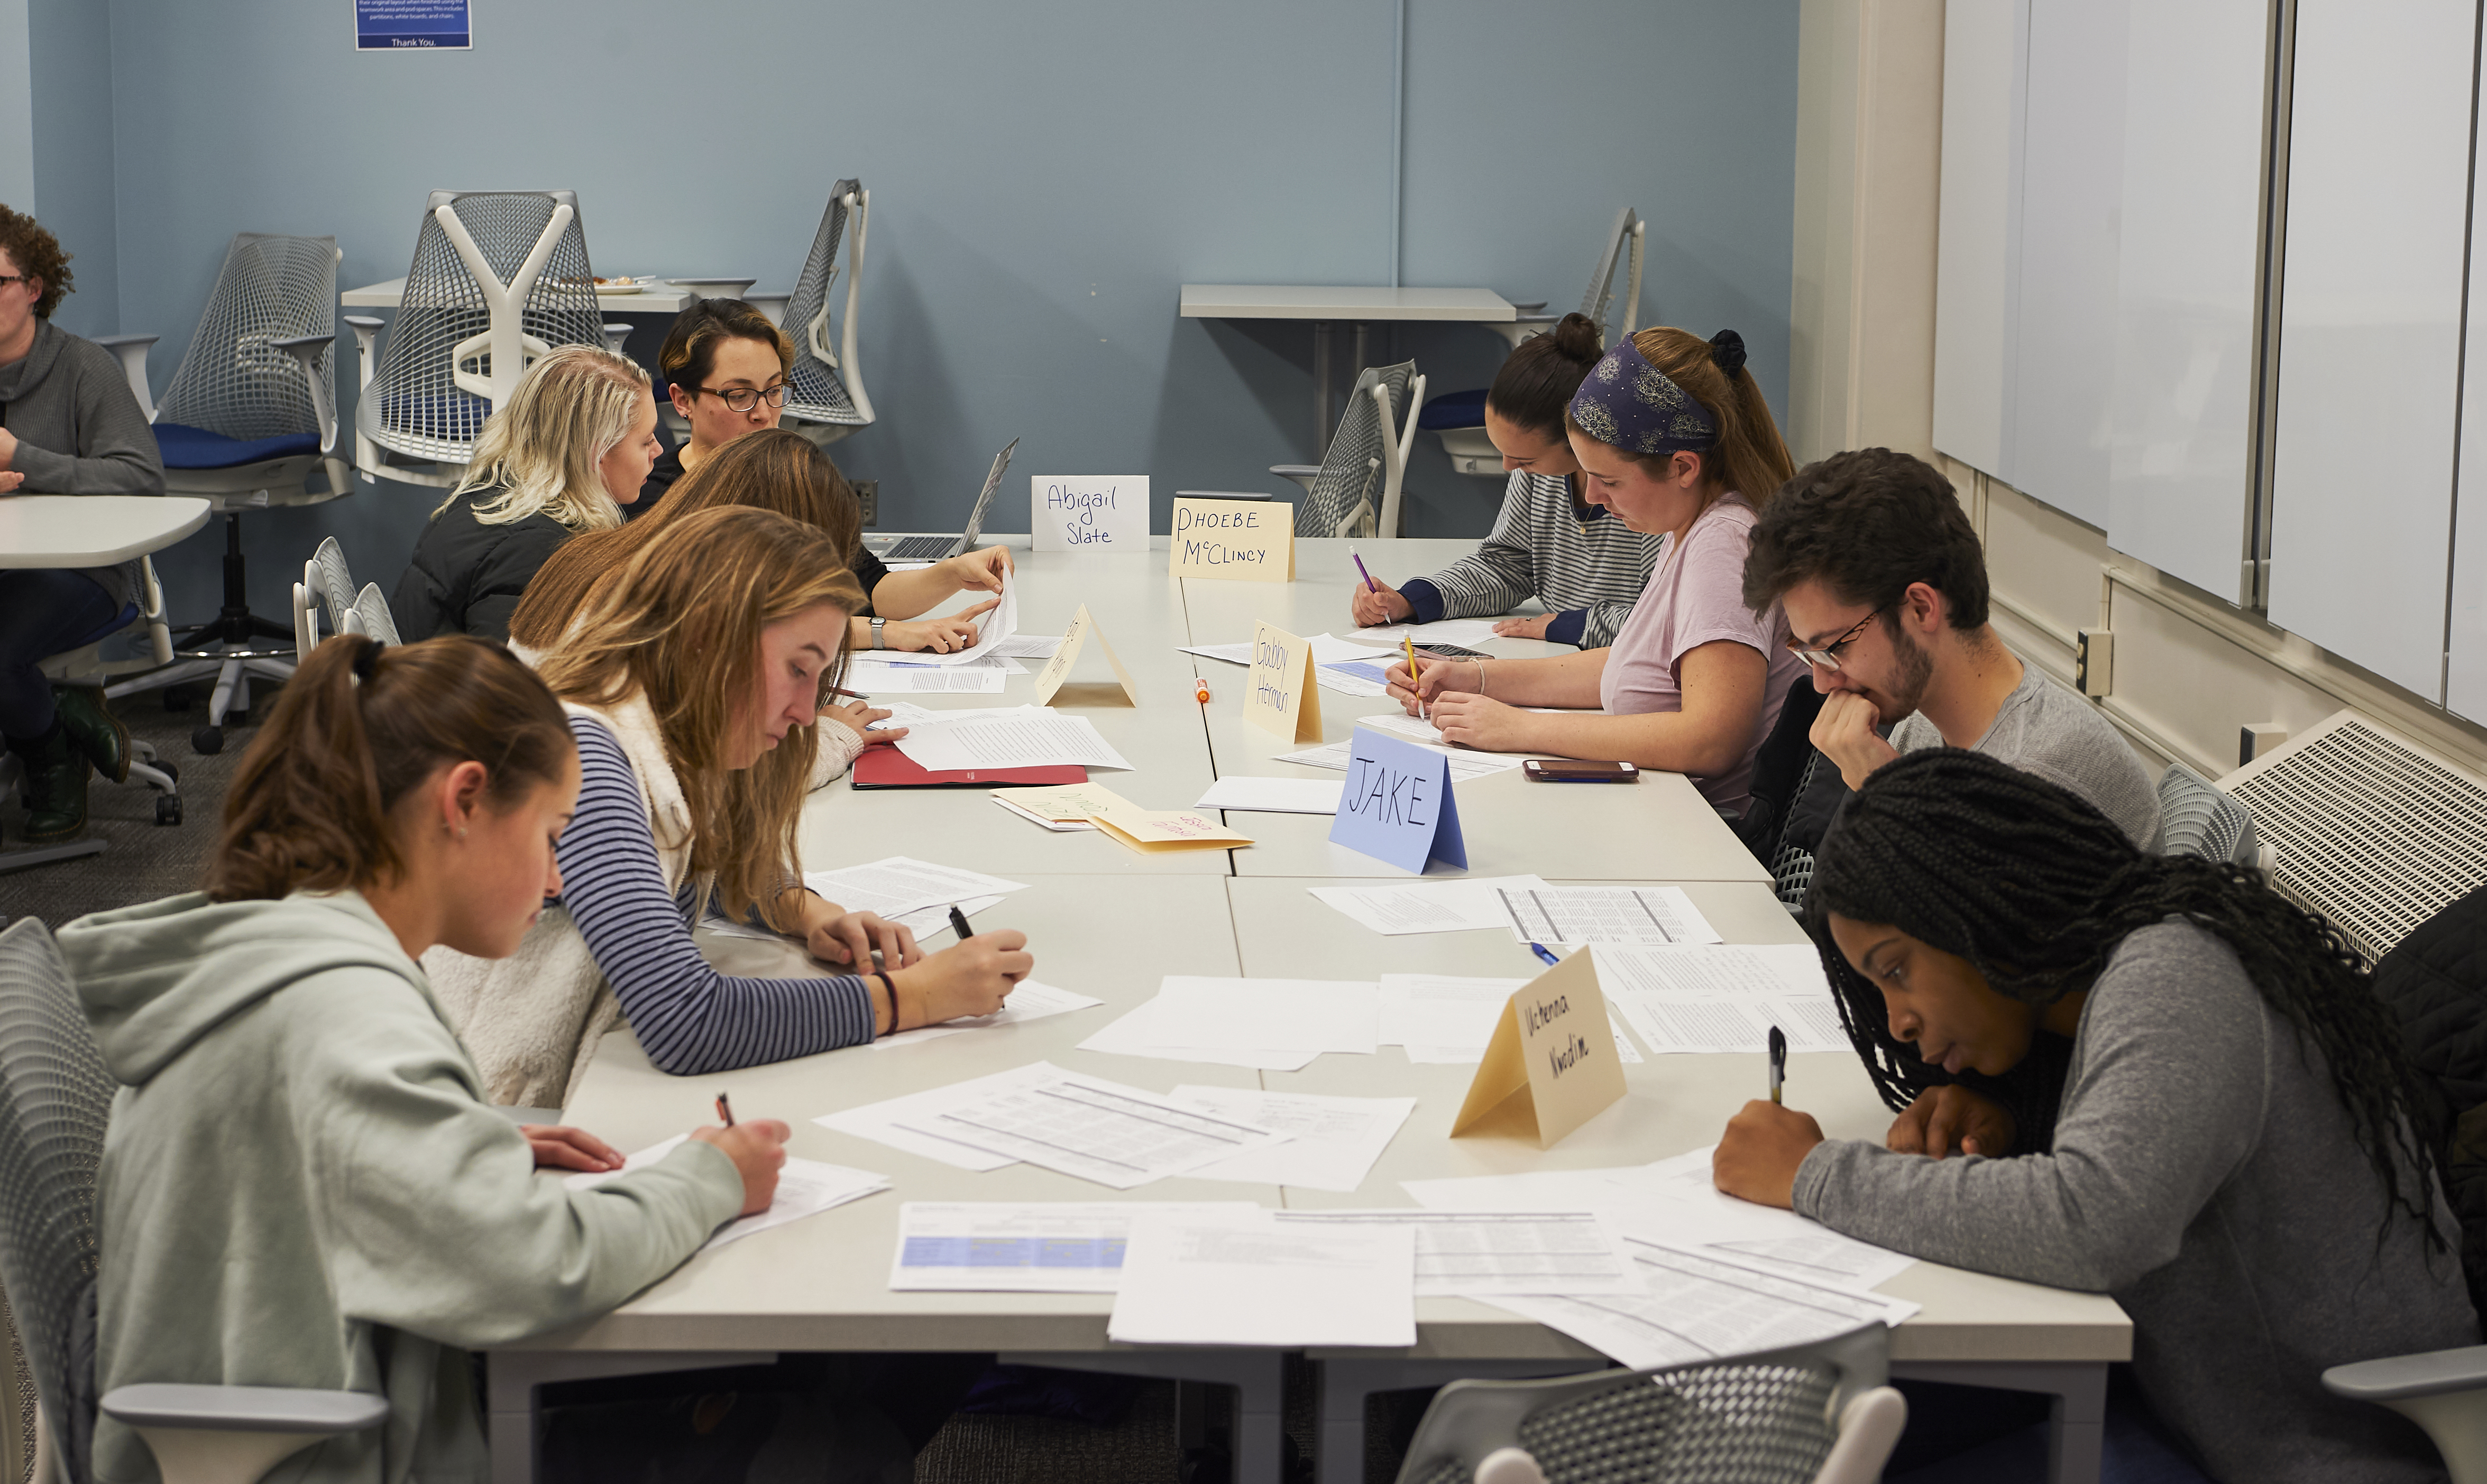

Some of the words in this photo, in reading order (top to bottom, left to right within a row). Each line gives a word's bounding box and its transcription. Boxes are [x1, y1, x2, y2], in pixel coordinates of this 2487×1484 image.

[391, 38, 417, 47] Thank
[418, 38, 436, 47] You.
[1048, 484, 1116, 525] Abigail
[1177, 508, 1260, 541] PHOEBE
[1067, 522, 1112, 545] Slate
[1256, 628, 1289, 688] Gabby
[1256, 674, 1288, 713] Herman
[1350, 758, 1427, 826] JAKE
[1525, 995, 1570, 1037] Uchenna
